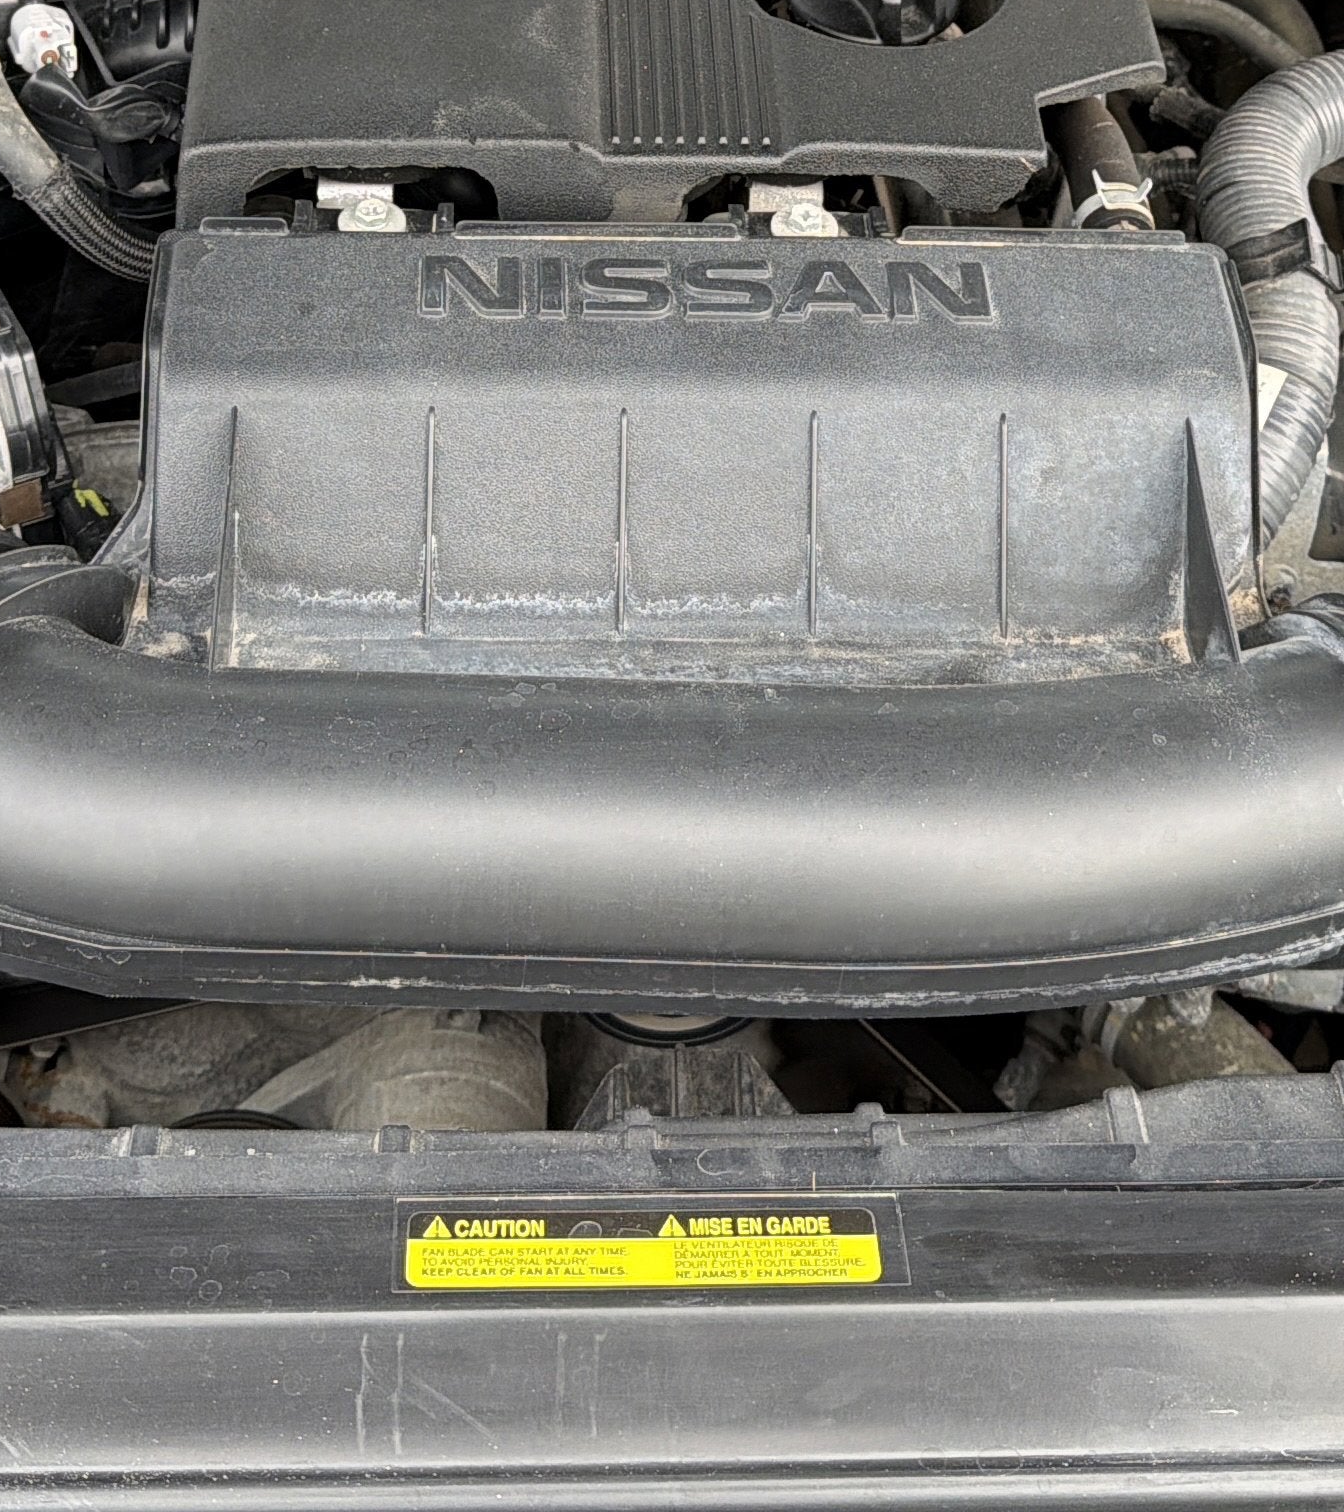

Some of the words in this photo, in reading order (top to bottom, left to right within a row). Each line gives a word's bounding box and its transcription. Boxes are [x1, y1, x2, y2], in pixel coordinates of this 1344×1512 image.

[419, 255, 994, 325] NISSAN
[454, 1219, 545, 1238] CAUTION
[689, 1217, 734, 1236] MISE
[737, 1217, 763, 1235] EN
[766, 1216, 832, 1235] GARDE
[673, 1241, 687, 1250] LE
[691, 1240, 771, 1250] VENTILATEUR
[822, 1238, 839, 1248] DE
[422, 1247, 445, 1257] FAN
[448, 1247, 485, 1257] BLADE
[488, 1247, 514, 1257] CAN
[517, 1247, 553, 1257] START
[556, 1247, 570, 1256] AT
[572, 1247, 597, 1256] ANY
[753, 1249, 784, 1258] TOUT
[422, 1257, 437, 1267] TO
[440, 1257, 476, 1267] AVOID
[478, 1257, 542, 1267] PERSONAL
[674, 1260, 708, 1269] POUR
[757, 1258, 798, 1268] TOUTE
[421, 1267, 453, 1277] KEEP
[456, 1267, 496, 1277] CLEAR
[499, 1267, 516, 1277] OF
[519, 1267, 543, 1276] FAN
[546, 1267, 561, 1276] AT
[563, 1267, 586, 1276] ALL
[675, 1270, 692, 1279] NE
[695, 1270, 738, 1279] JAMAIS
[756, 1268, 773, 1278] EN
[775, 1268, 848, 1277] APPROCHER
